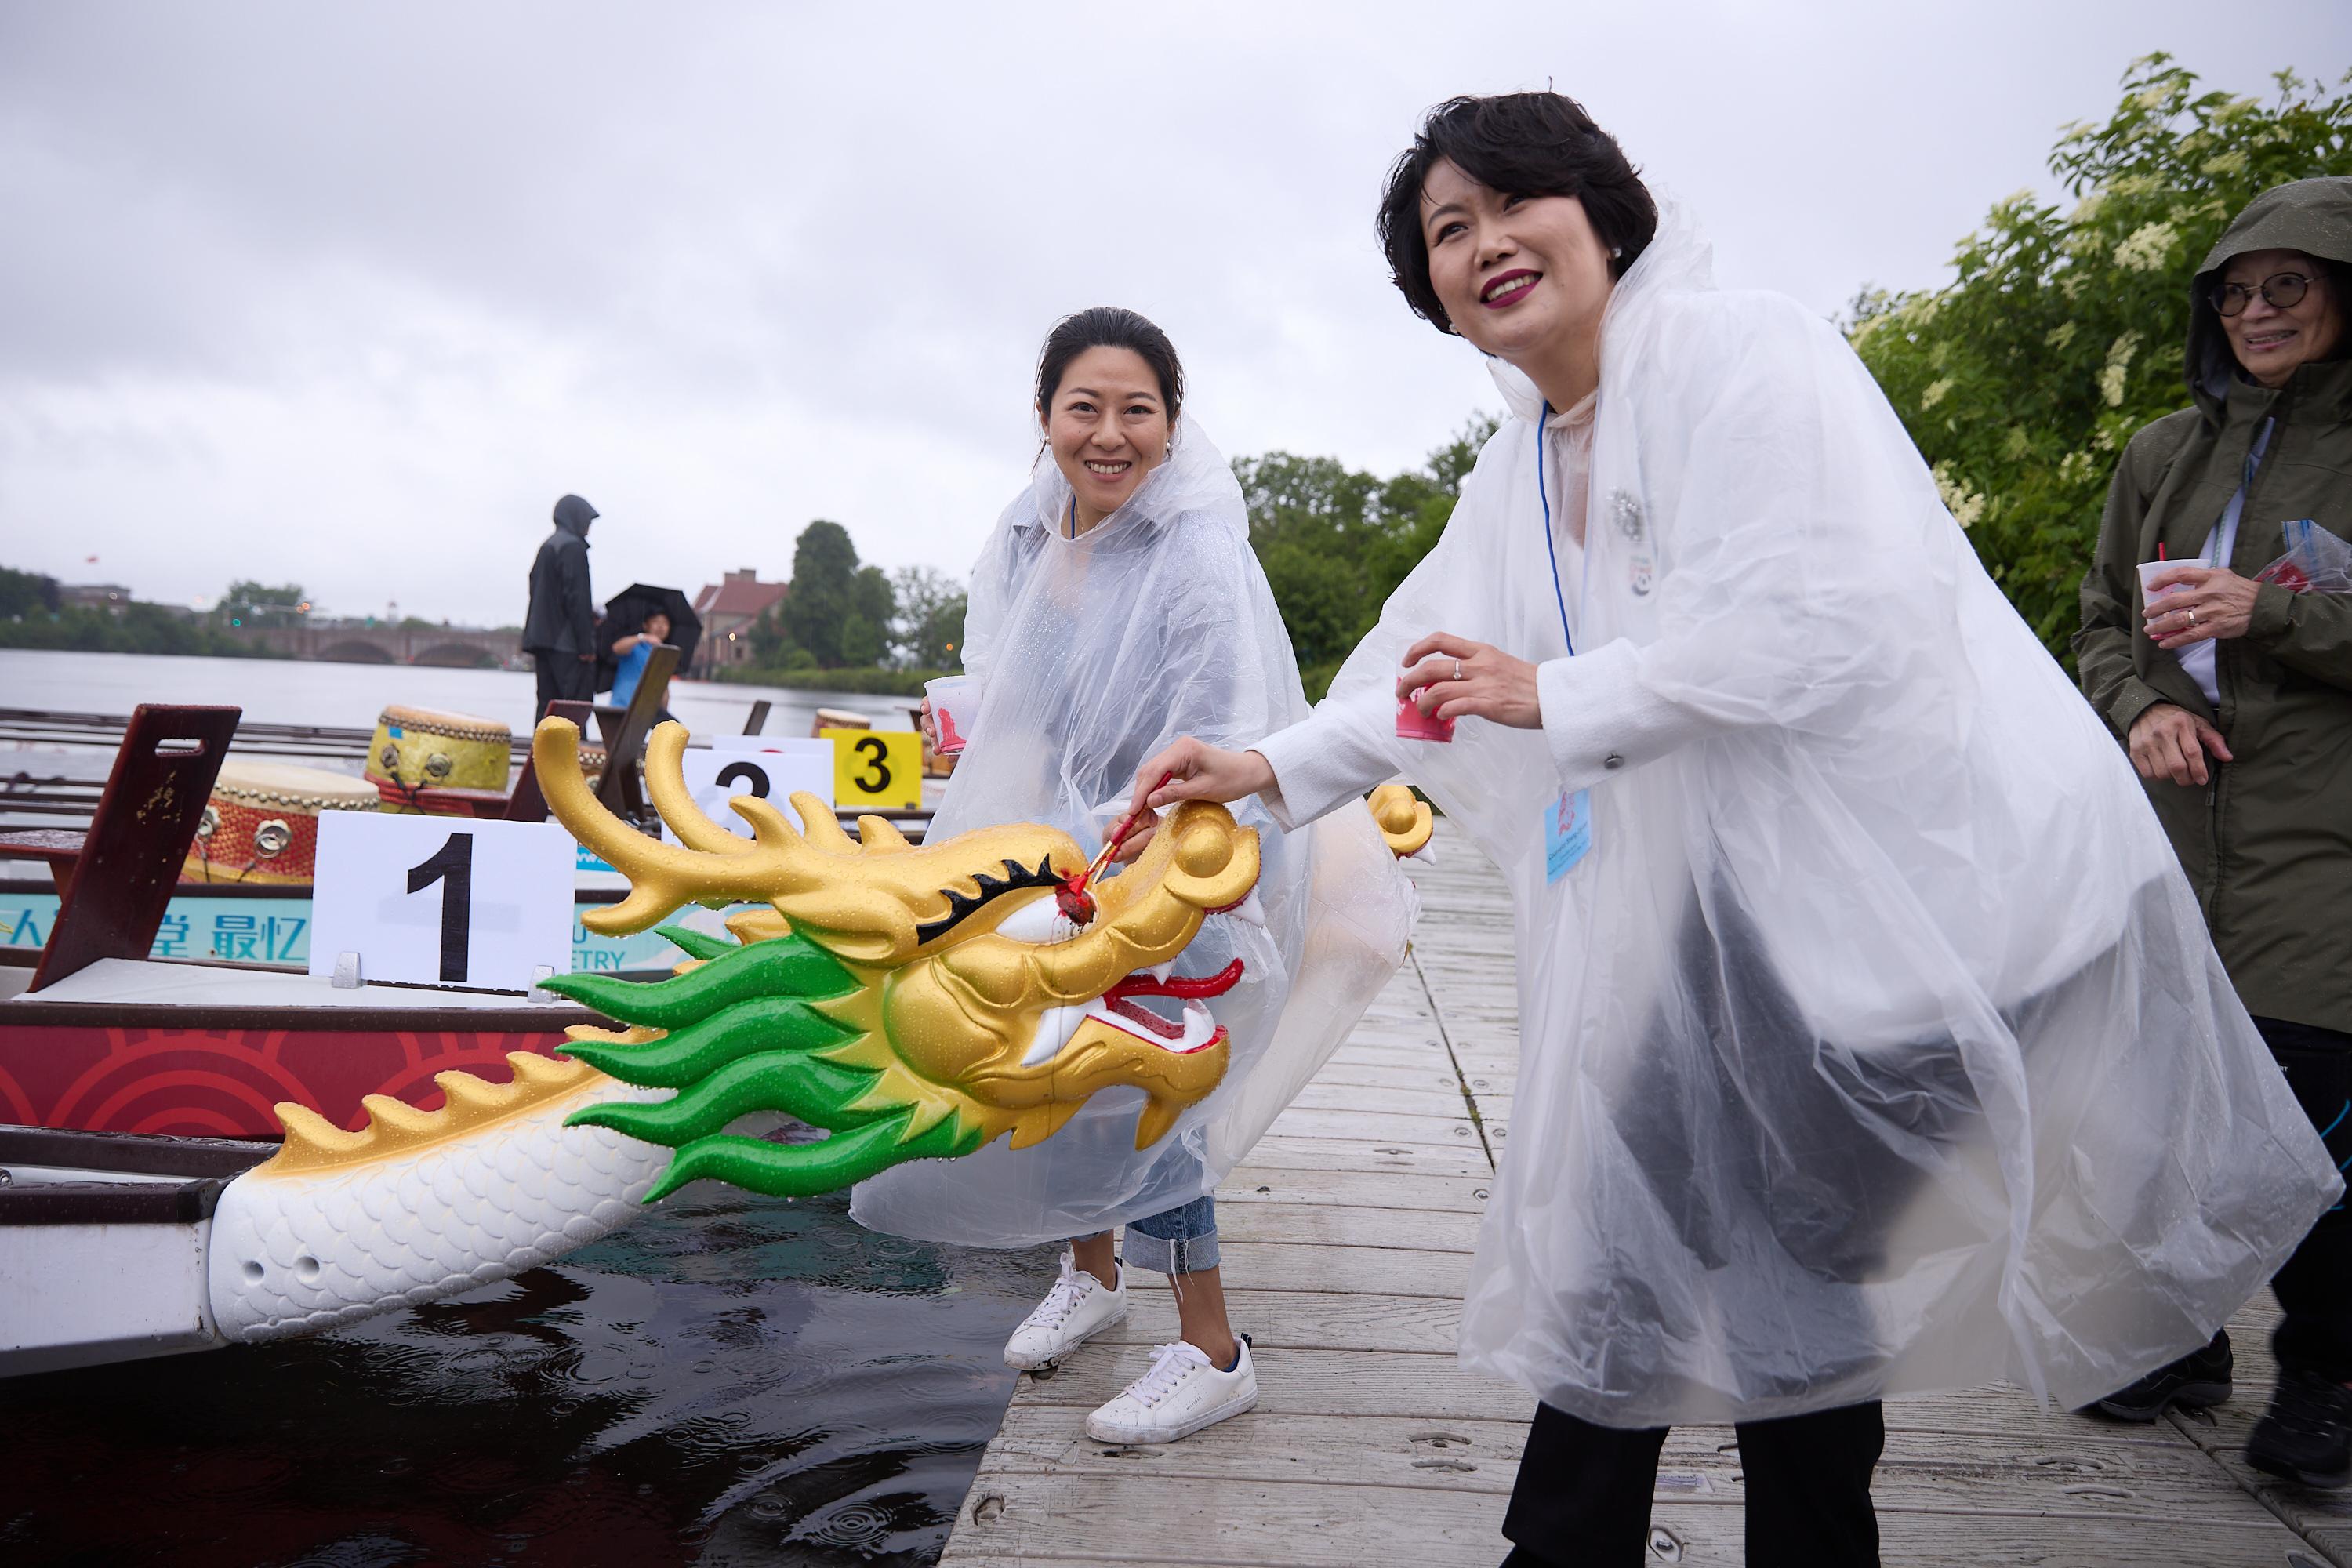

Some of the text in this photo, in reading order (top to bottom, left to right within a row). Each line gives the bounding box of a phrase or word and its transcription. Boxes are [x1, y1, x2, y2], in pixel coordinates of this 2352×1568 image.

[854, 737, 891, 793] 3
[407, 833, 473, 982] 1
[212, 915, 307, 960] 最忆
